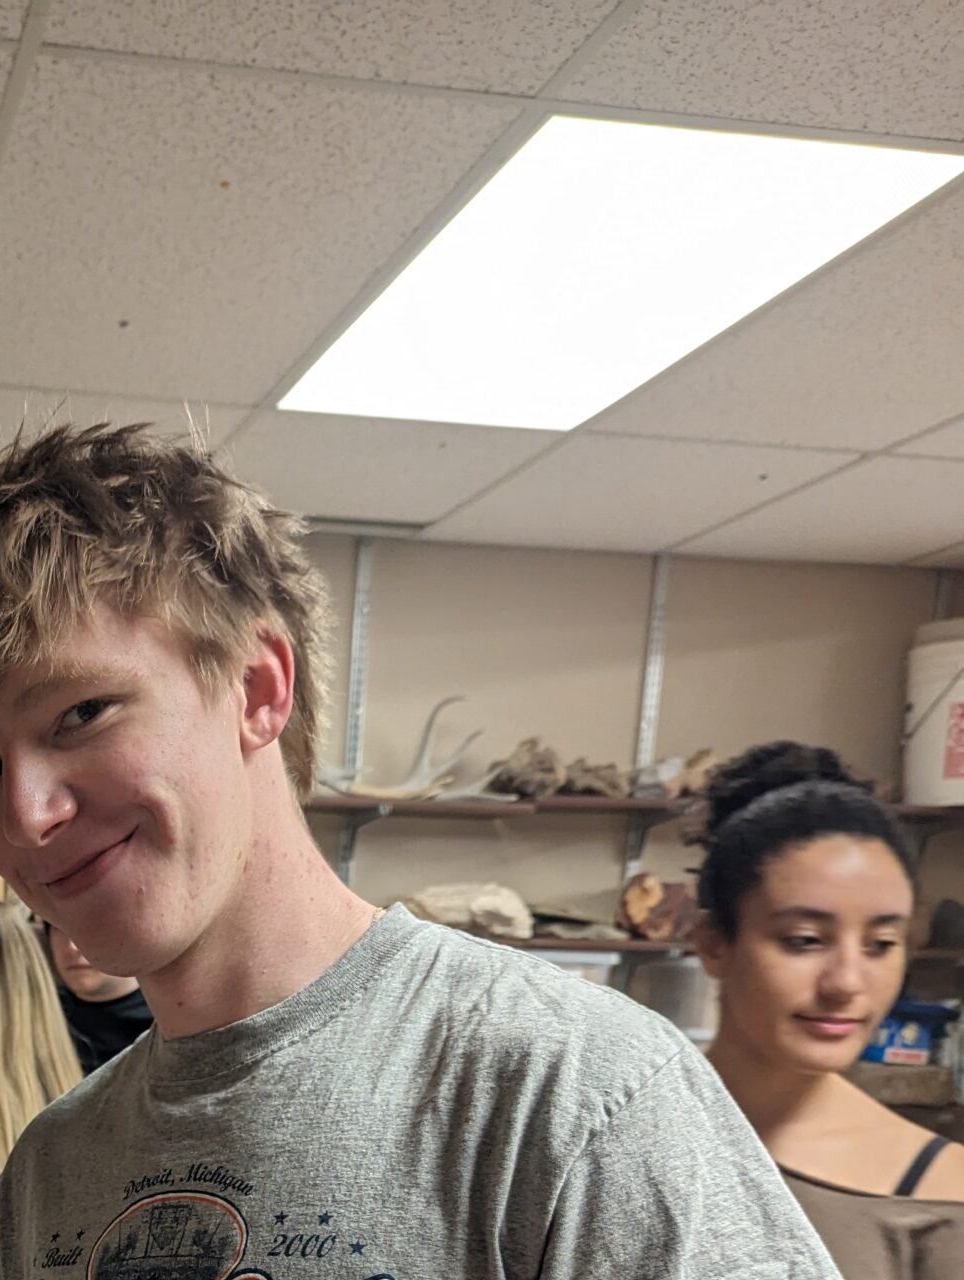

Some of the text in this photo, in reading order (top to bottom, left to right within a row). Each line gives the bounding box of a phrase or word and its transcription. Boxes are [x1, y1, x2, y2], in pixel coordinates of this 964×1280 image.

[123, 1163, 255, 1200] Detroit, Michigan
[41, 1232, 337, 1269] Built 2000
